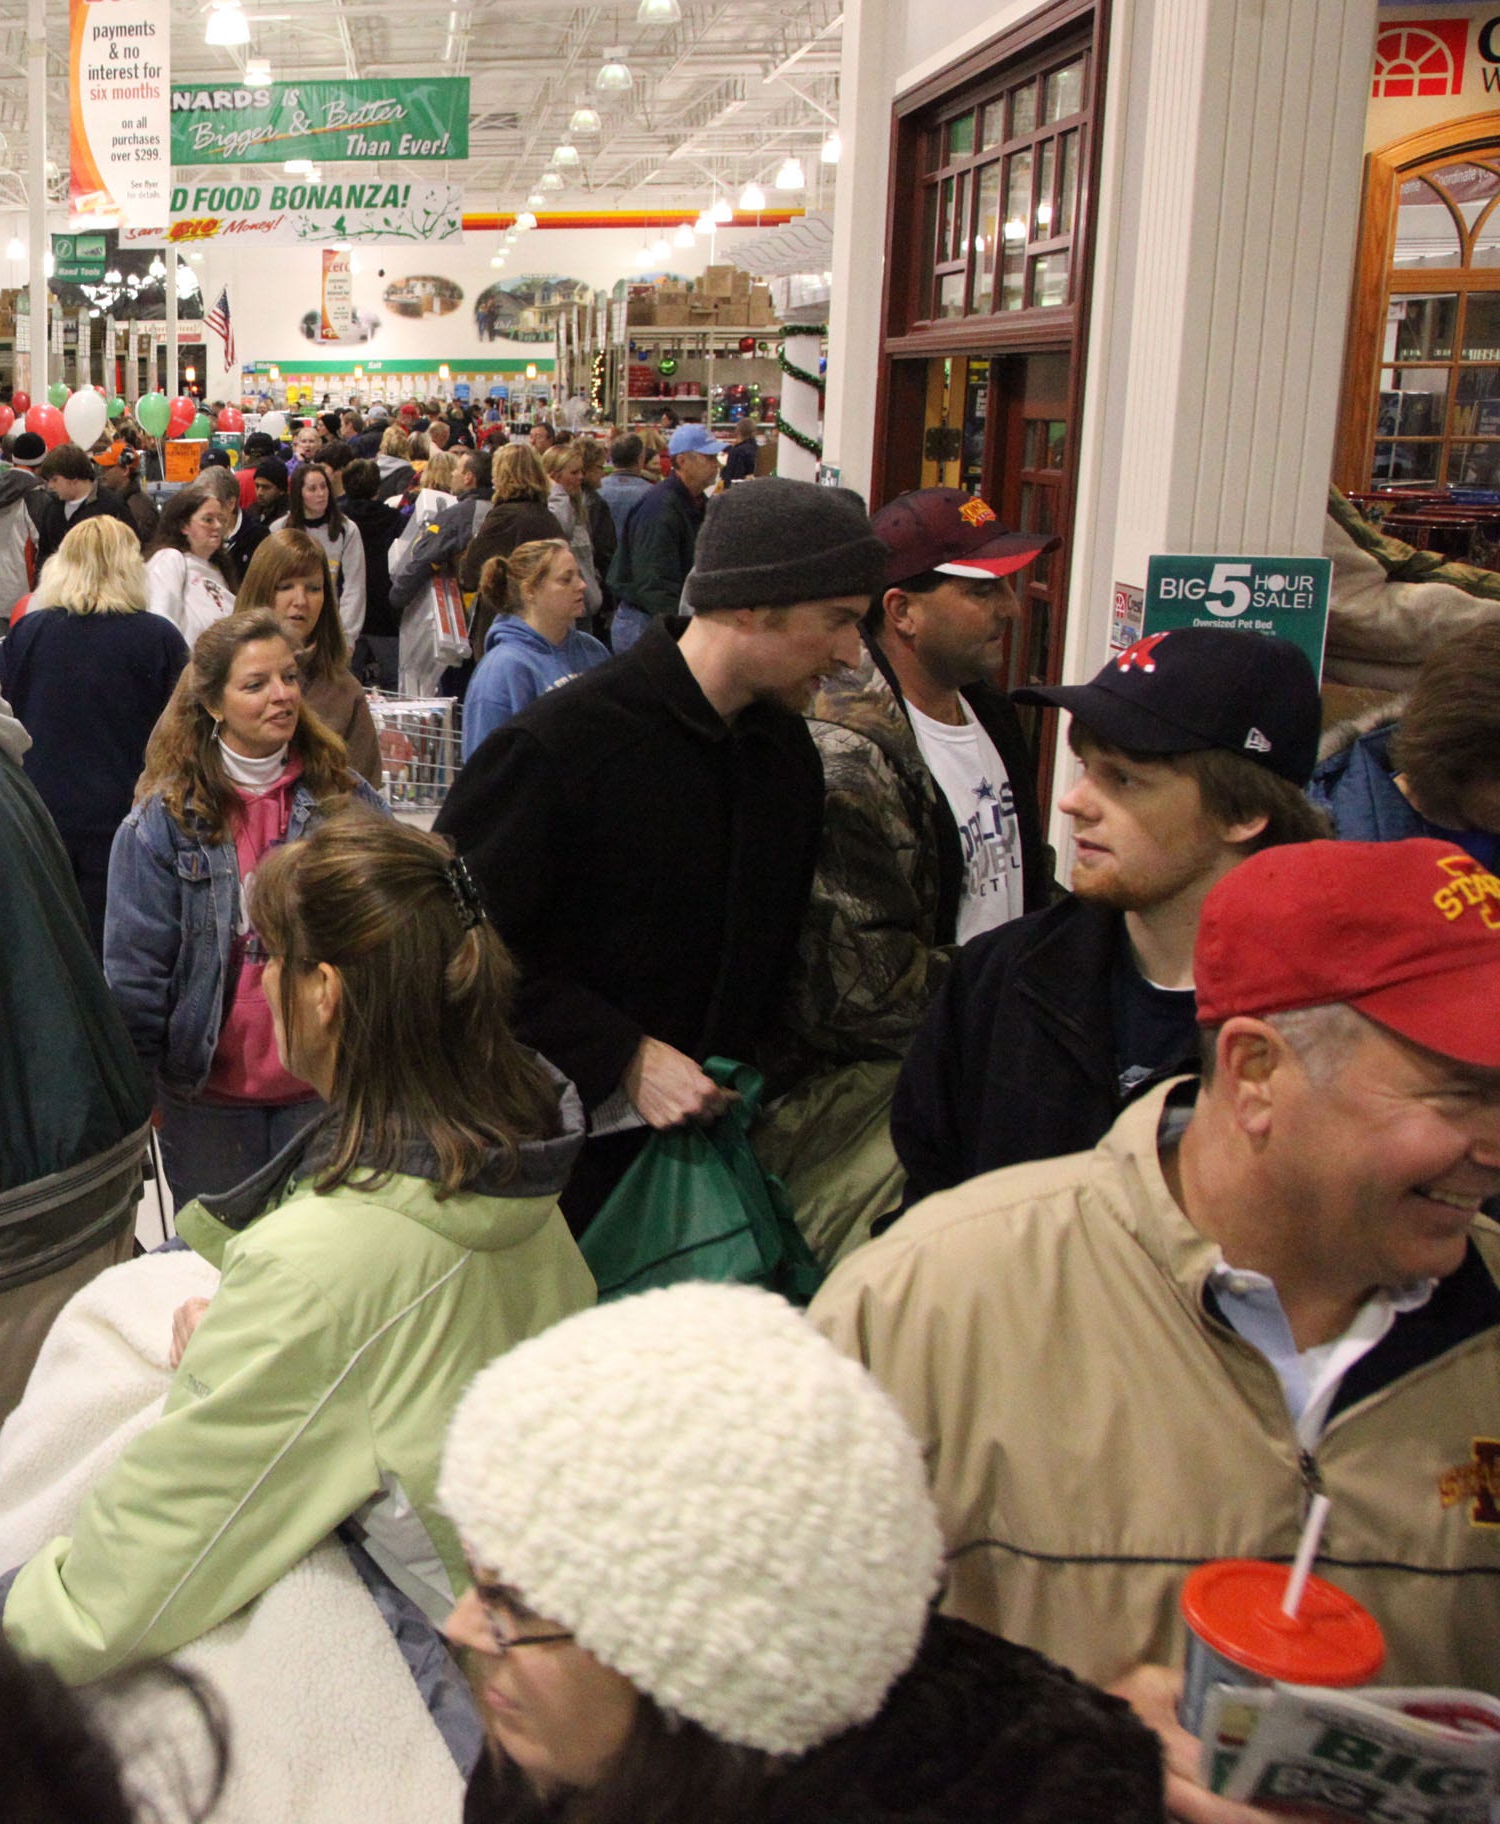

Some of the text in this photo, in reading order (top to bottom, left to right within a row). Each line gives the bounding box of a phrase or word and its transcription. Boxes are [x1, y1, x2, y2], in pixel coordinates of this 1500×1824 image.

[93, 20, 156, 42] payments
[109, 42, 140, 60] & no
[88, 62, 162, 80] interest for
[90, 82, 160, 101] six months
[171, 89, 270, 111] NARDS
[121, 116, 148, 129] on all
[189, 98, 408, 157] Bigger & Better
[112, 133, 160, 148] purchases
[346, 132, 450, 157] Than Ever!
[110, 148, 162, 162] over $299.
[131, 180, 142, 189] See
[192, 187, 262, 212] FOOD
[269, 183, 412, 211] BONANZA!
[222, 215, 285, 236] Money!
[58, 267, 100, 276] Hand Tools
[1159, 563, 1252, 617] BIG 5
[1254, 574, 1314, 592] HOUR
[1253, 592, 1312, 609] SALE!
[1193, 618, 1273, 630] Oversized Pet Bed
